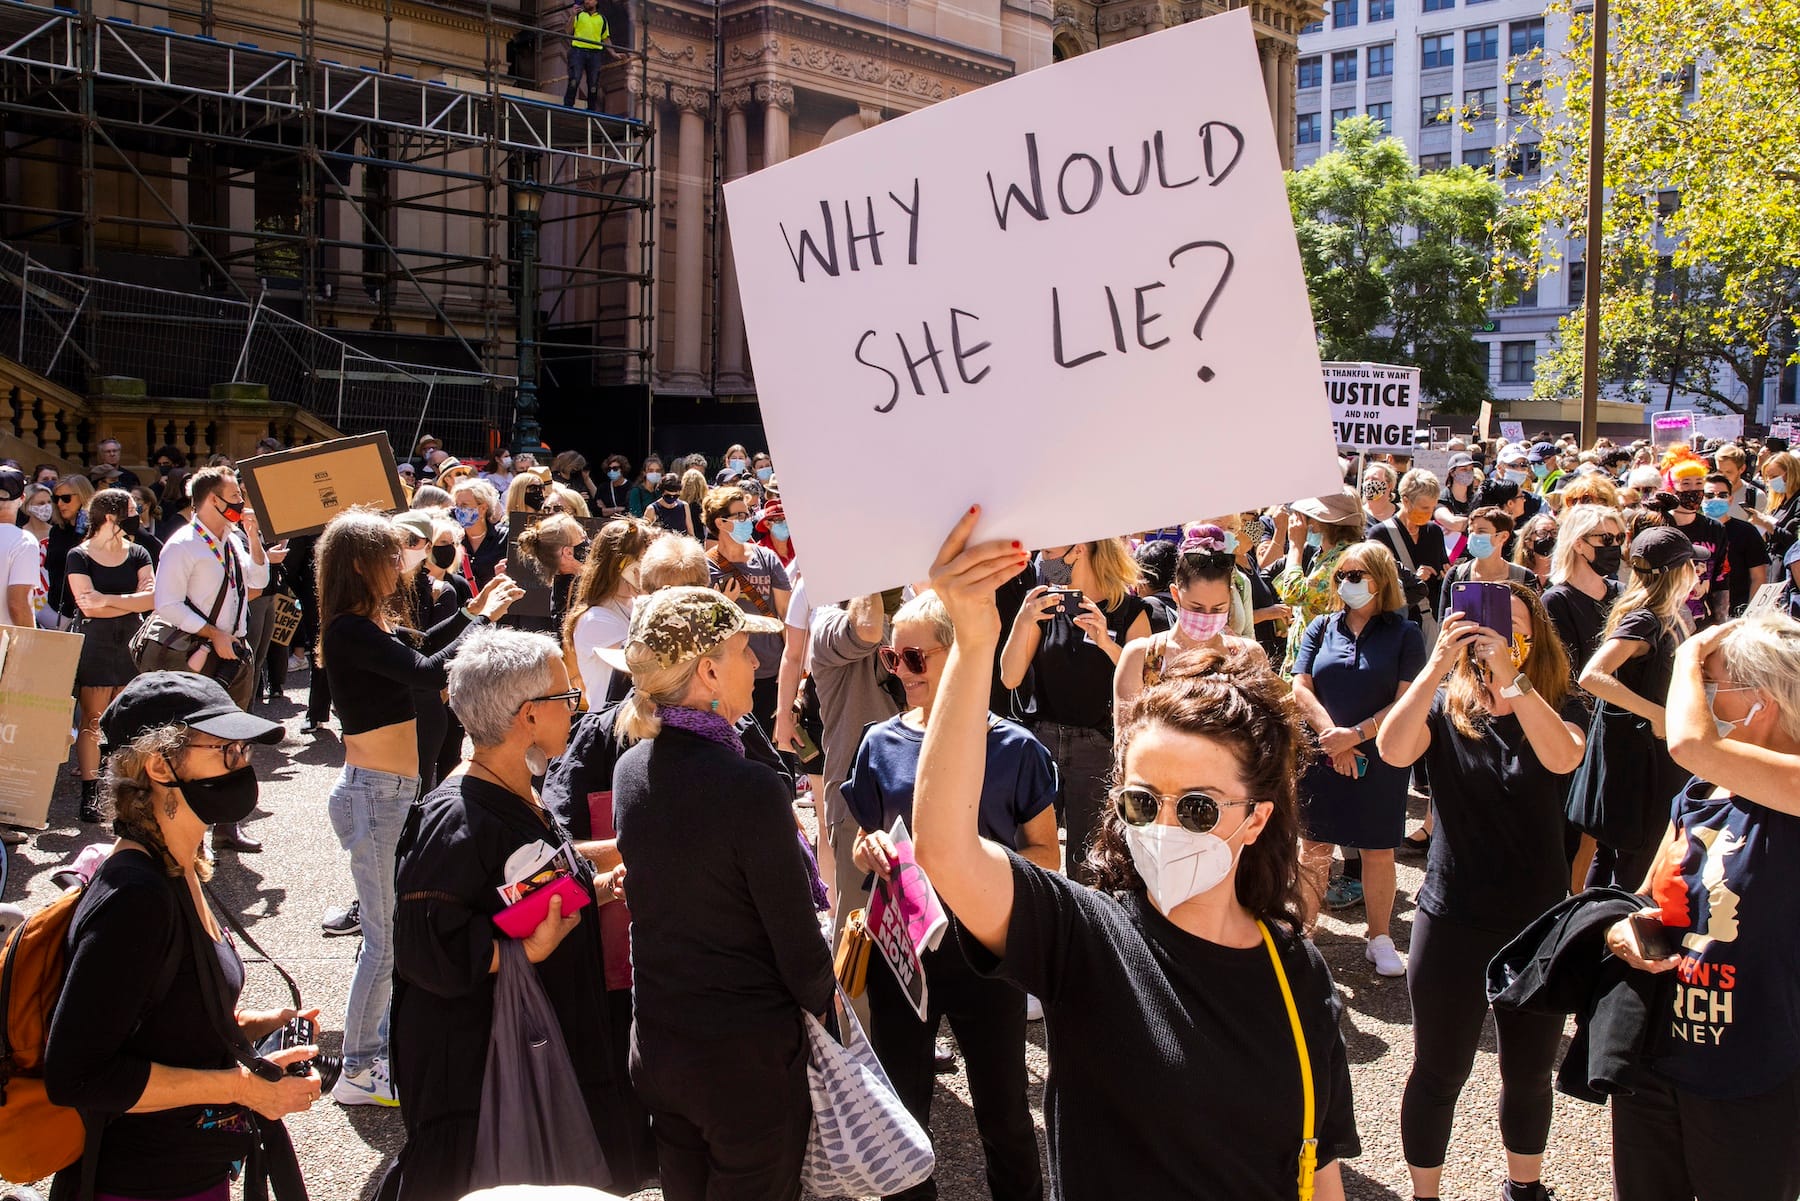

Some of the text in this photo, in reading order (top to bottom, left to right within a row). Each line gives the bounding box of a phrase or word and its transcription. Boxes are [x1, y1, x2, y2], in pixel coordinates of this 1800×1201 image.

[779, 120, 1245, 283] WHY WOULD
[854, 240, 1235, 414] SHE LIE?
[1332, 369, 1370, 378] THANKFUL
[1372, 371, 1385, 379] WE
[1387, 371, 1410, 380] WANT
[1345, 410, 1380, 419] AND NOT
[878, 923, 913, 986] NOW
[882, 904, 915, 971] RAPE
